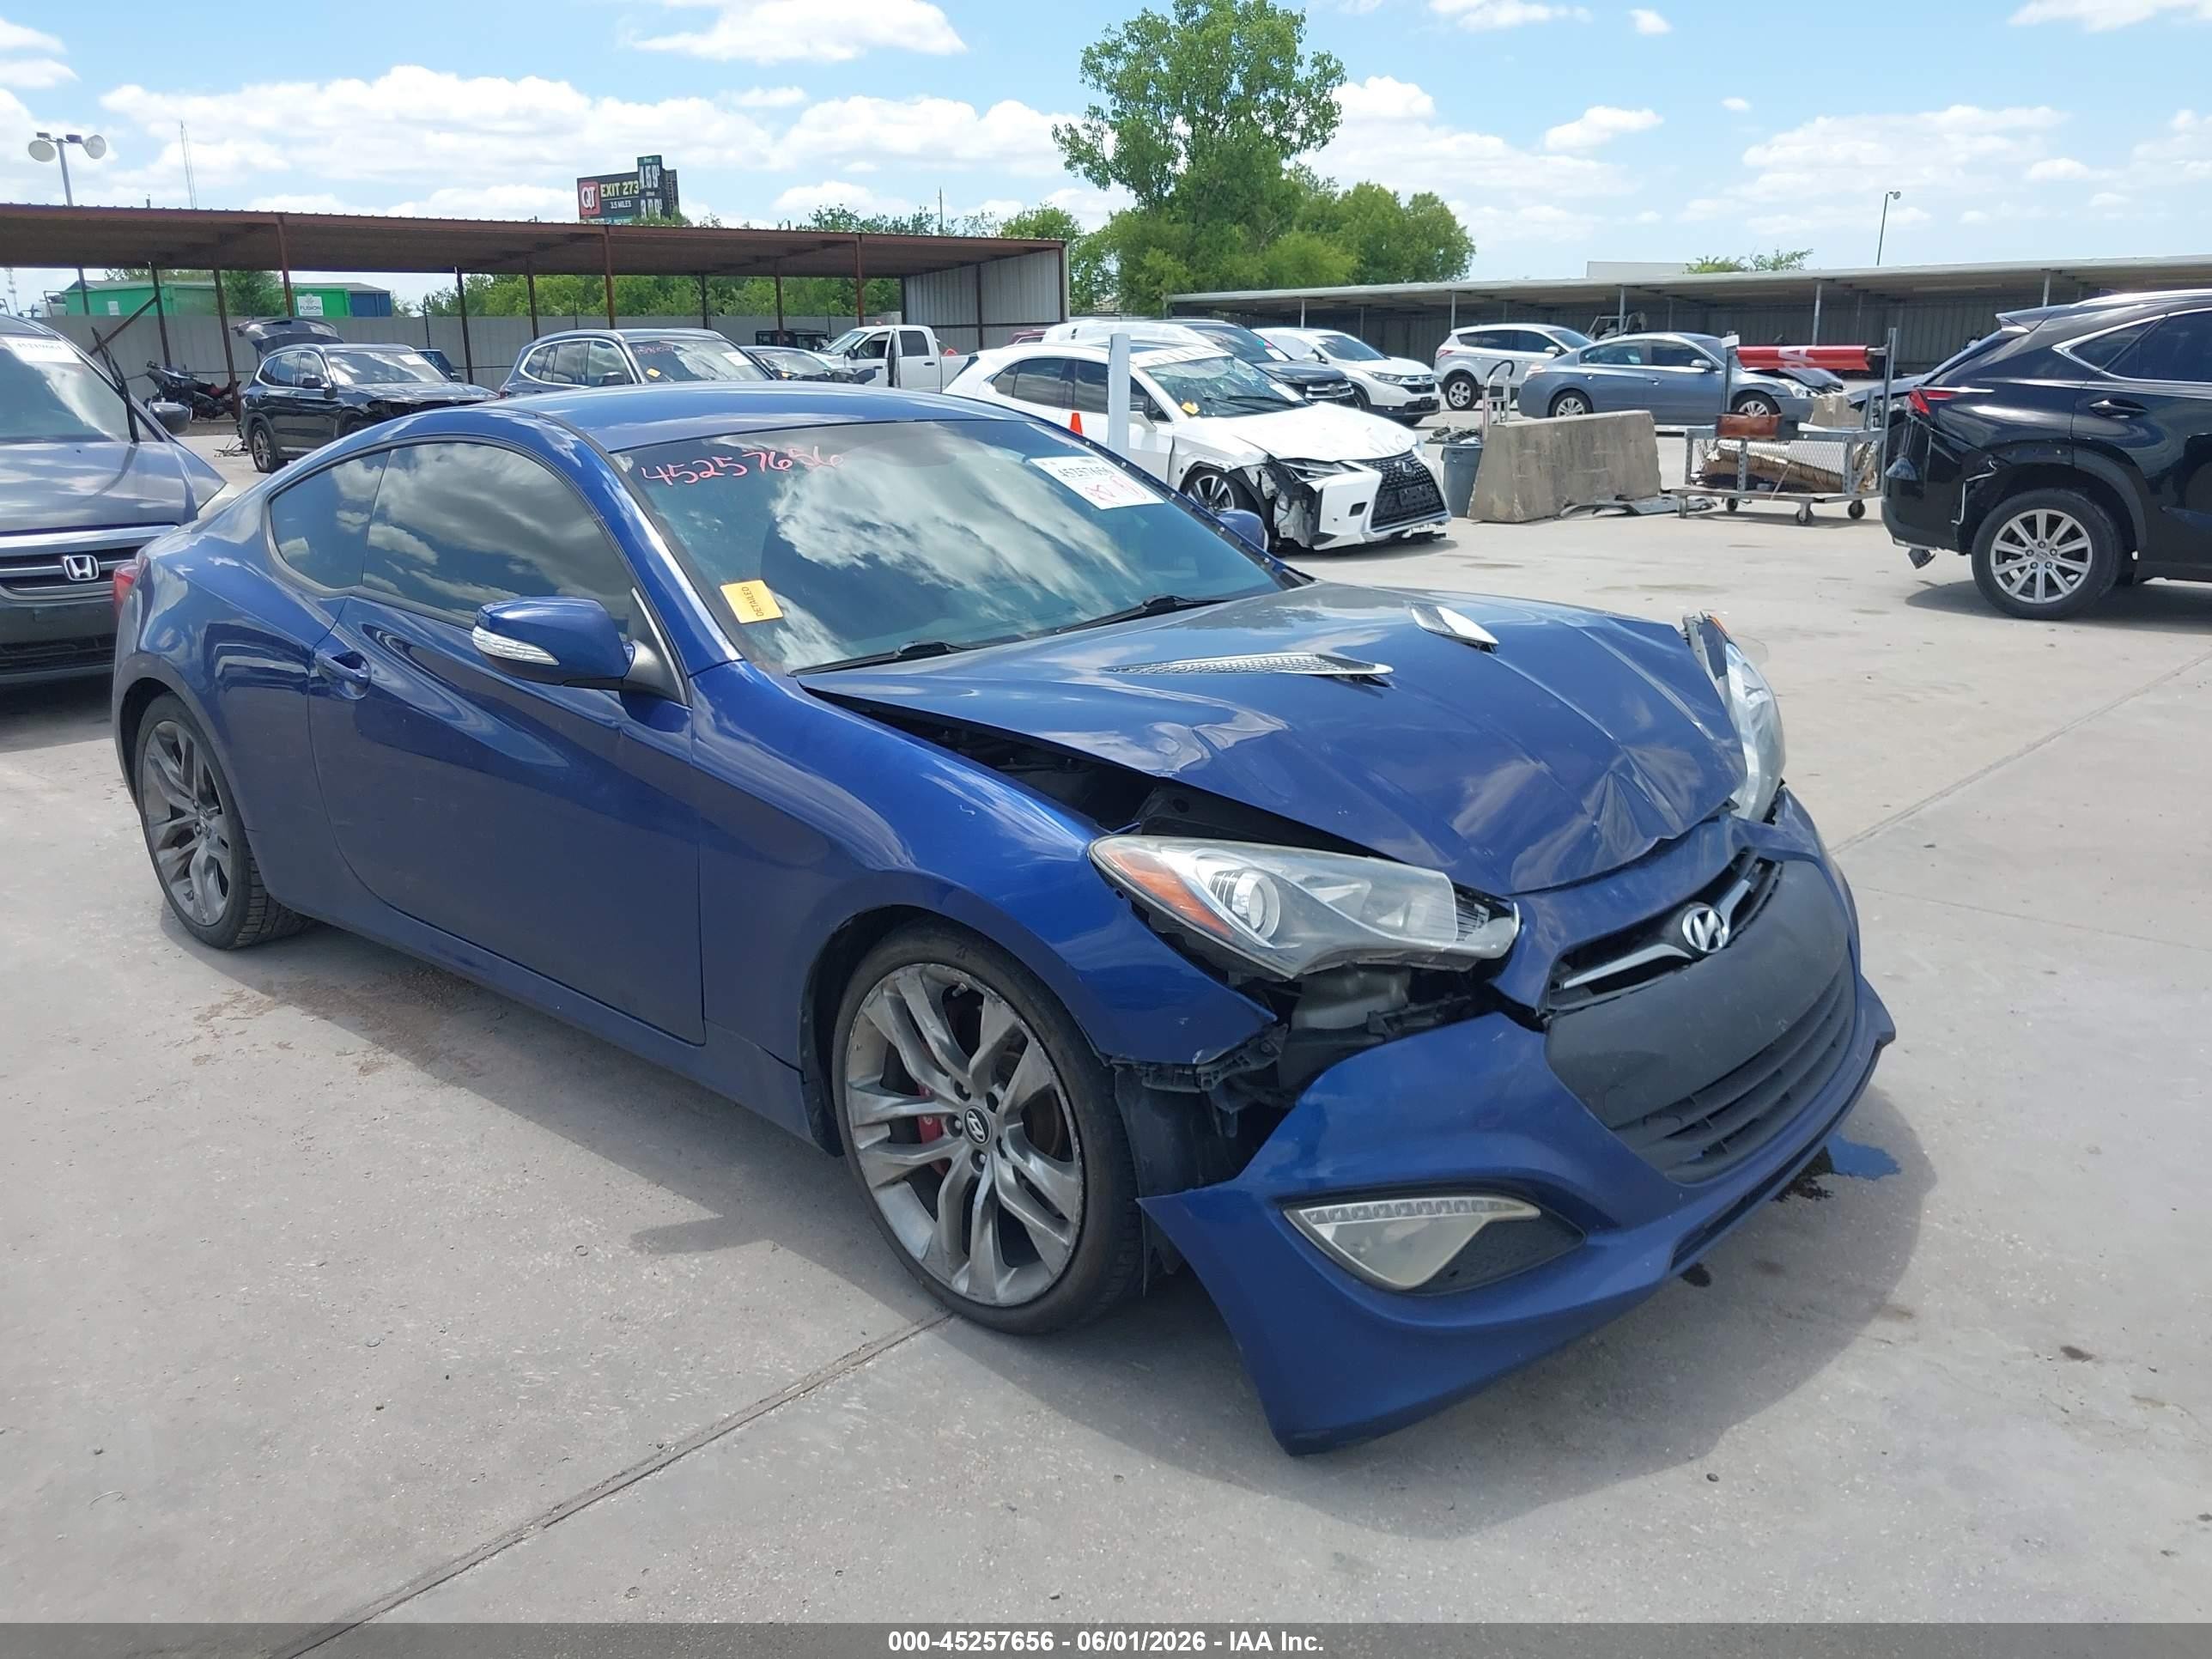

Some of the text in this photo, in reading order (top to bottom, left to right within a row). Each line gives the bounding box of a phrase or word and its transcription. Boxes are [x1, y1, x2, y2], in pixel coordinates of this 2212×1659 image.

[581, 186, 597, 209] QT
[600, 179, 639, 198] EXIT 273
[617, 200, 631, 209] MILES
[641, 446, 844, 486] 45257656
[741, 586, 764, 617] DETAILED
